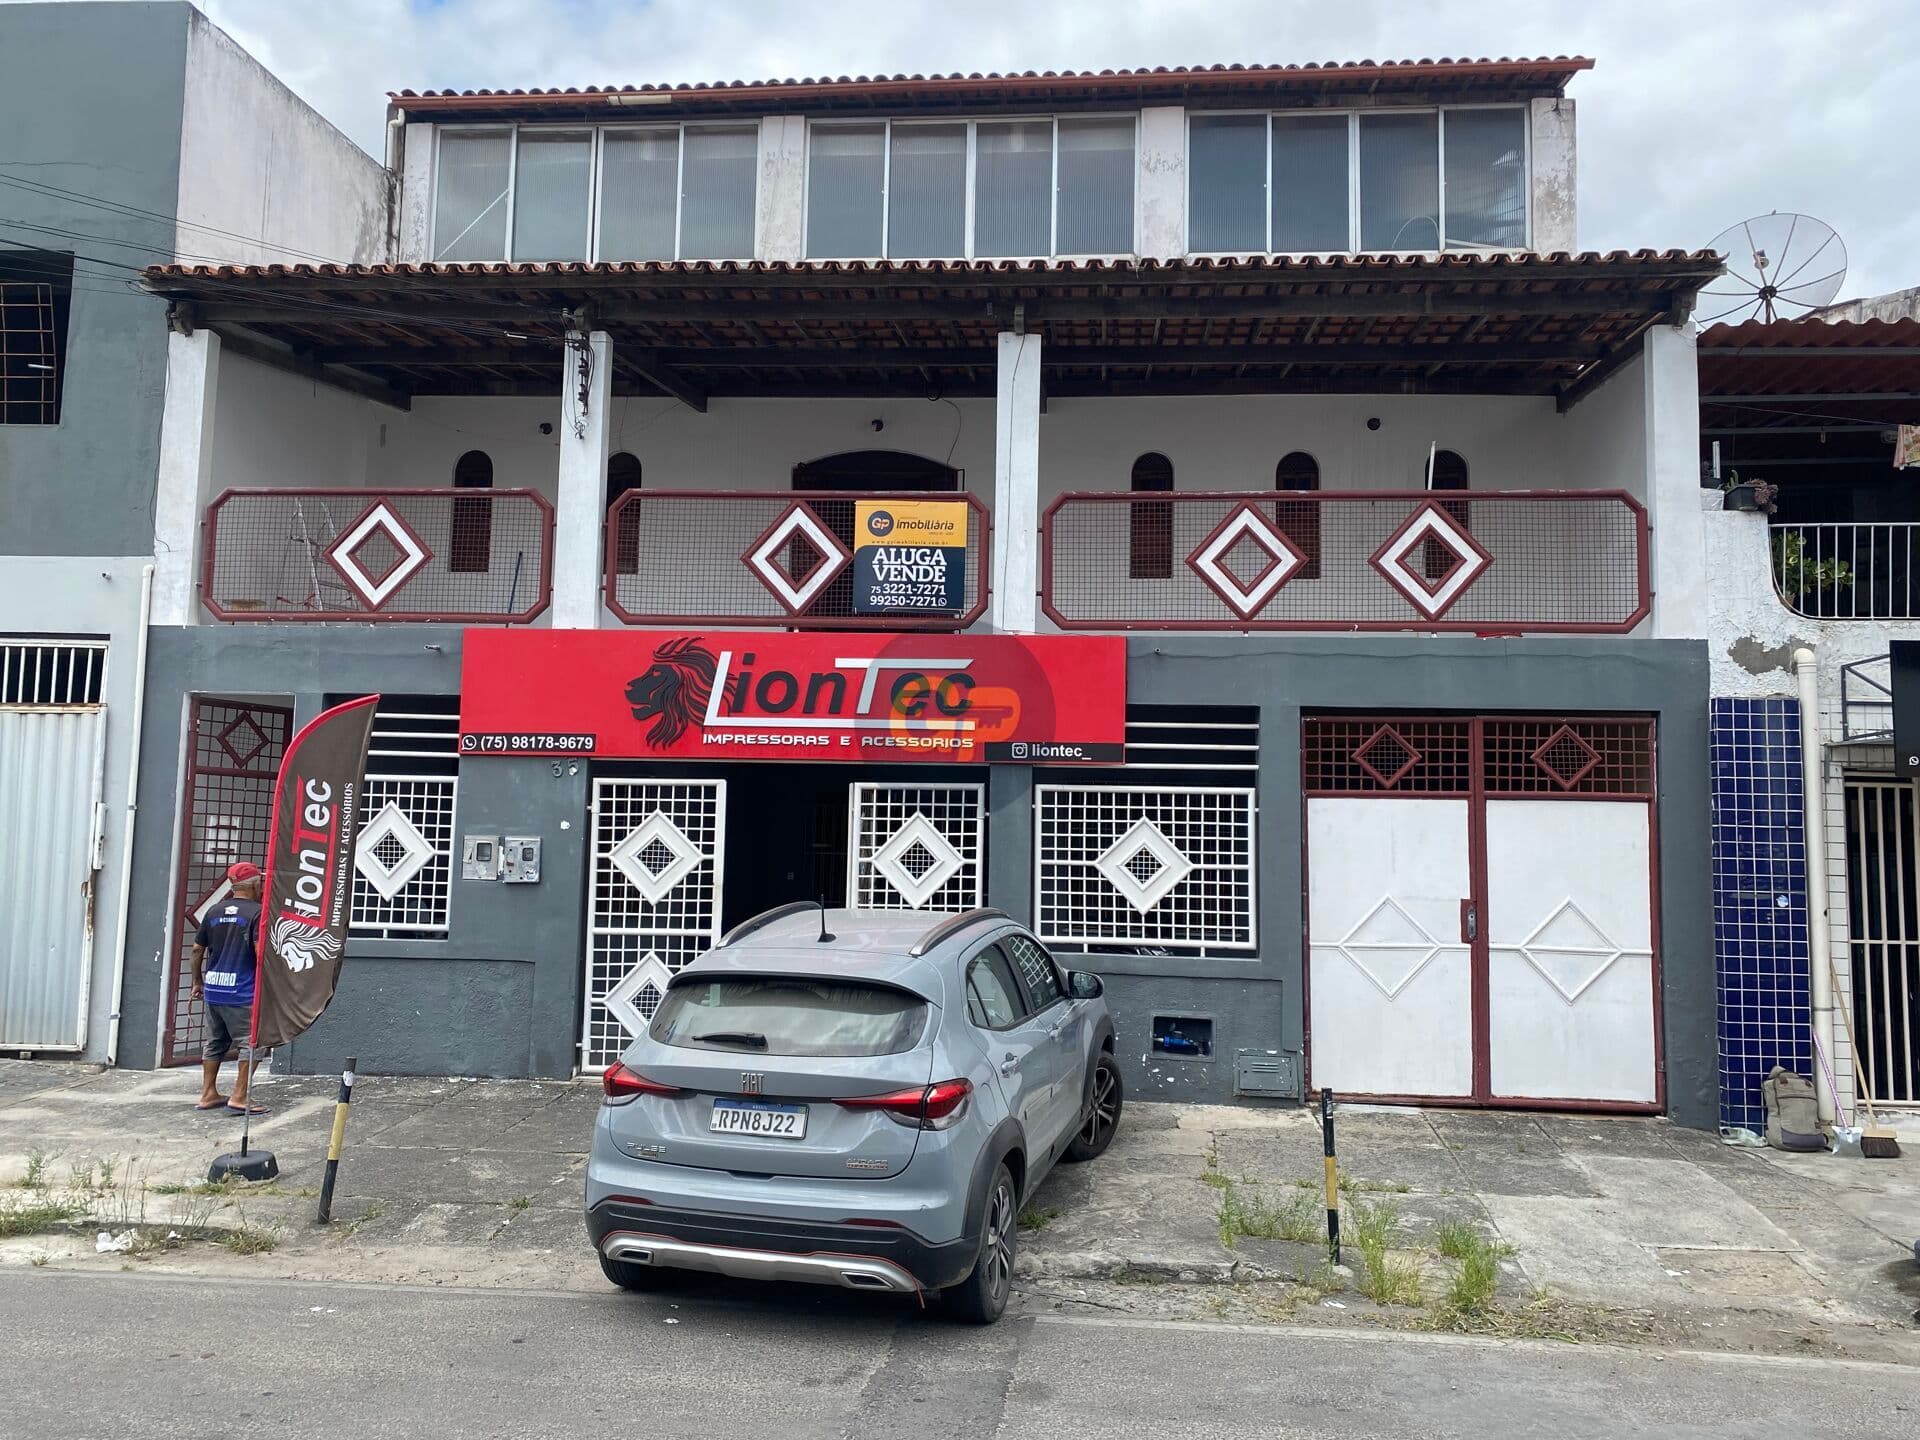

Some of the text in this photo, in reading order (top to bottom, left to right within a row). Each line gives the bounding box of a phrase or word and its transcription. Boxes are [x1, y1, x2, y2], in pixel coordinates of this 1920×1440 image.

[872, 548, 947, 566] ALUGA
[872, 565, 946, 582] VENDE
[870, 584, 946, 595] 75 3221-7271
[869, 596, 938, 606] 99250-7271
[480, 735, 594, 751] (75) 98178-9679
[703, 733, 975, 748] IMPRESSORAS E ACESSORIOS
[331, 857, 348, 926] IMPRESSORAS
[741, 1072, 764, 1093] FIAT
[718, 1110, 795, 1134] RPN8J22
